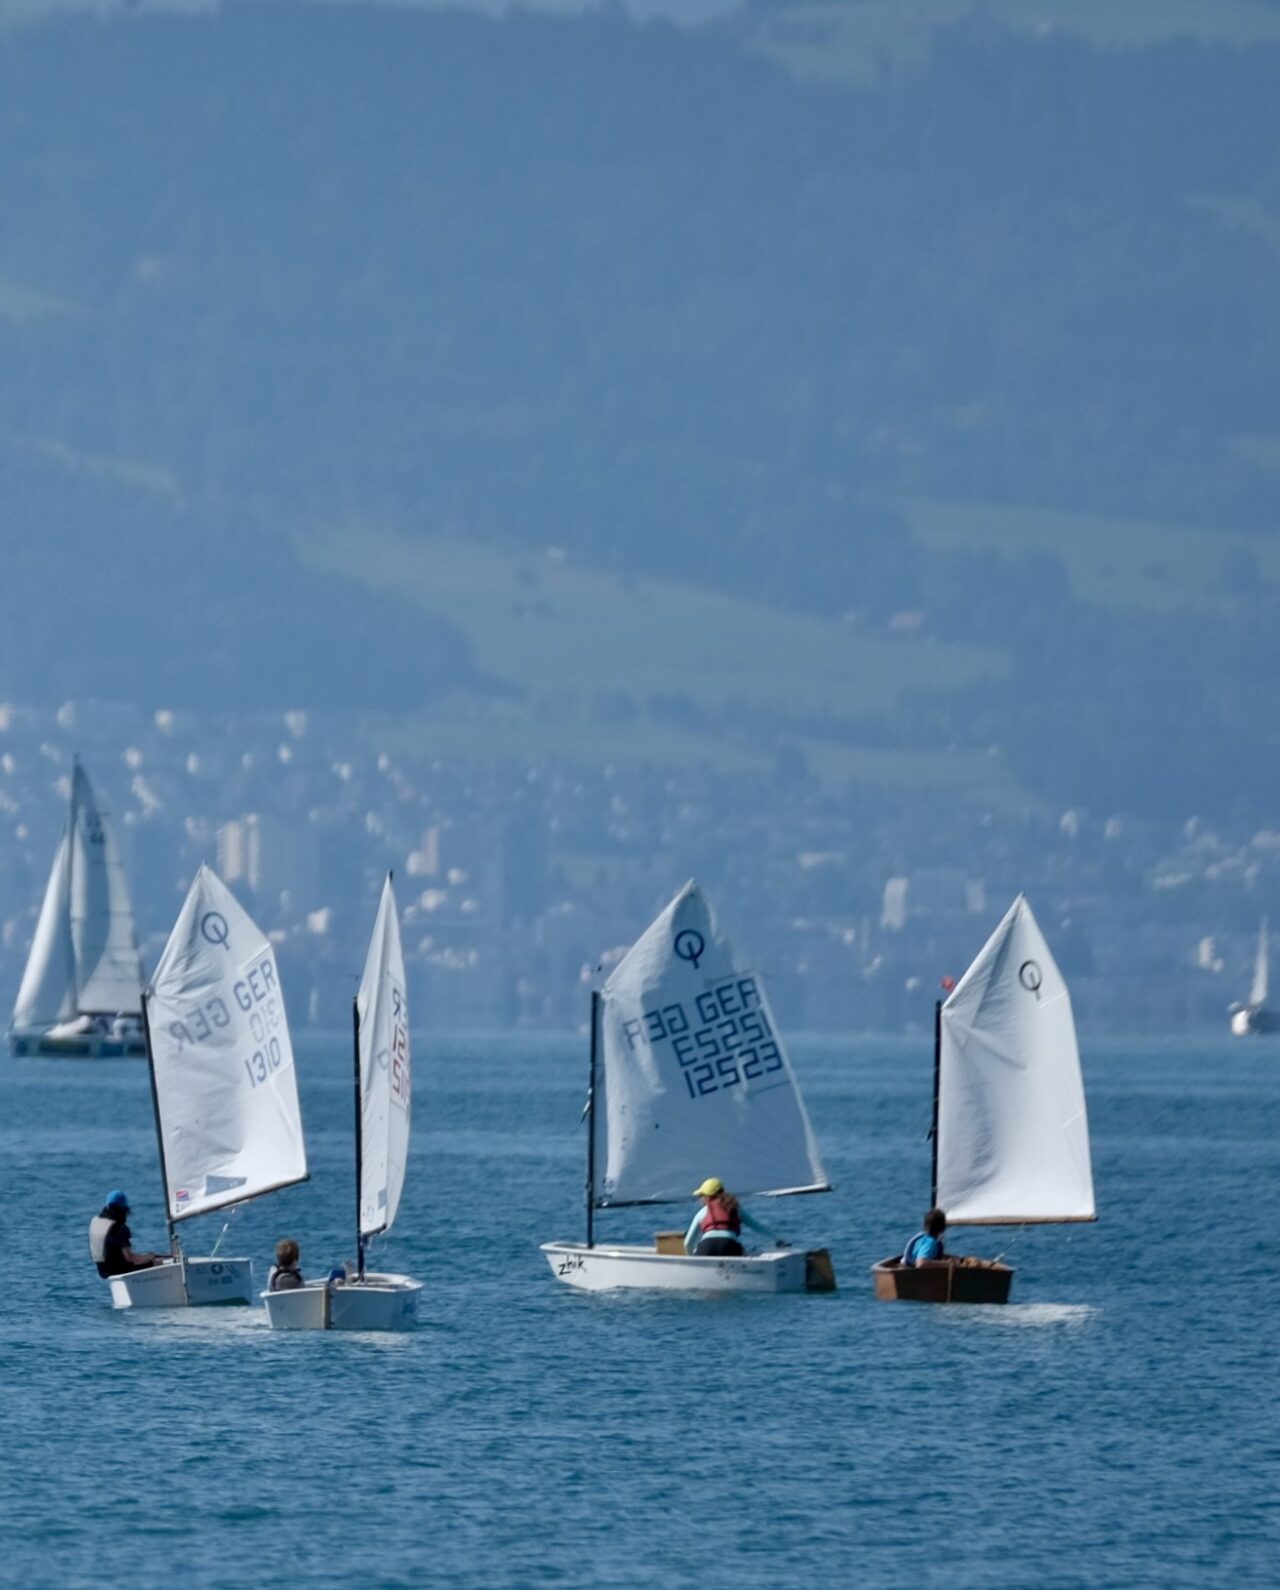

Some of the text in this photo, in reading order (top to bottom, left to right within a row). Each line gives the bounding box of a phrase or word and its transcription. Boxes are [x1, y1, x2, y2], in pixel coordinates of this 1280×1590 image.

[233, 958, 276, 1012] GER
[695, 977, 761, 1025] GER
[244, 1036, 281, 1089] 1310
[684, 1040, 784, 1099] 12523
